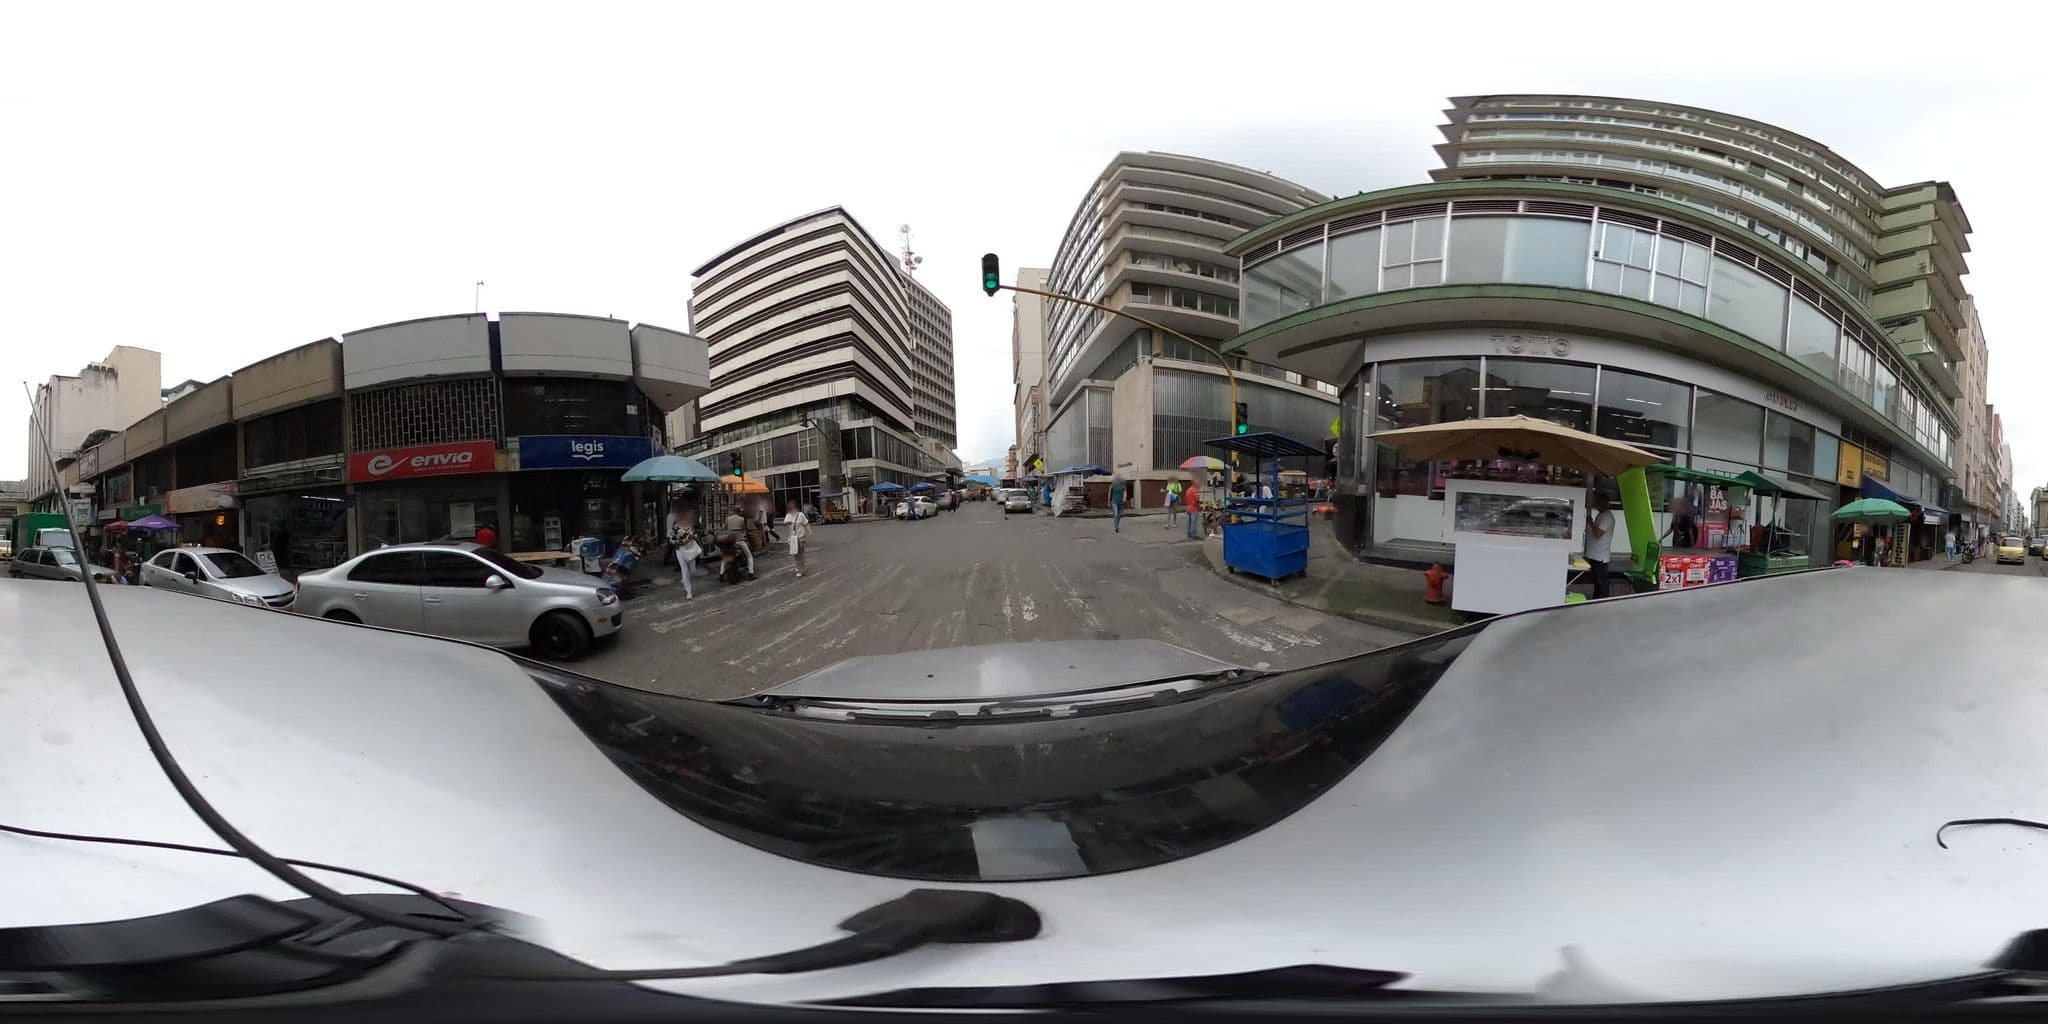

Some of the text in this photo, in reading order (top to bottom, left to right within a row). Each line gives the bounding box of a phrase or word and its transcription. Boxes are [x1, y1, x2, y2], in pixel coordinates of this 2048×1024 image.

[571, 440, 604, 455] legis
[1710, 490, 1723, 500] BA
[1709, 500, 1727, 511] JAS
[1665, 574, 1682, 584] 2x1
